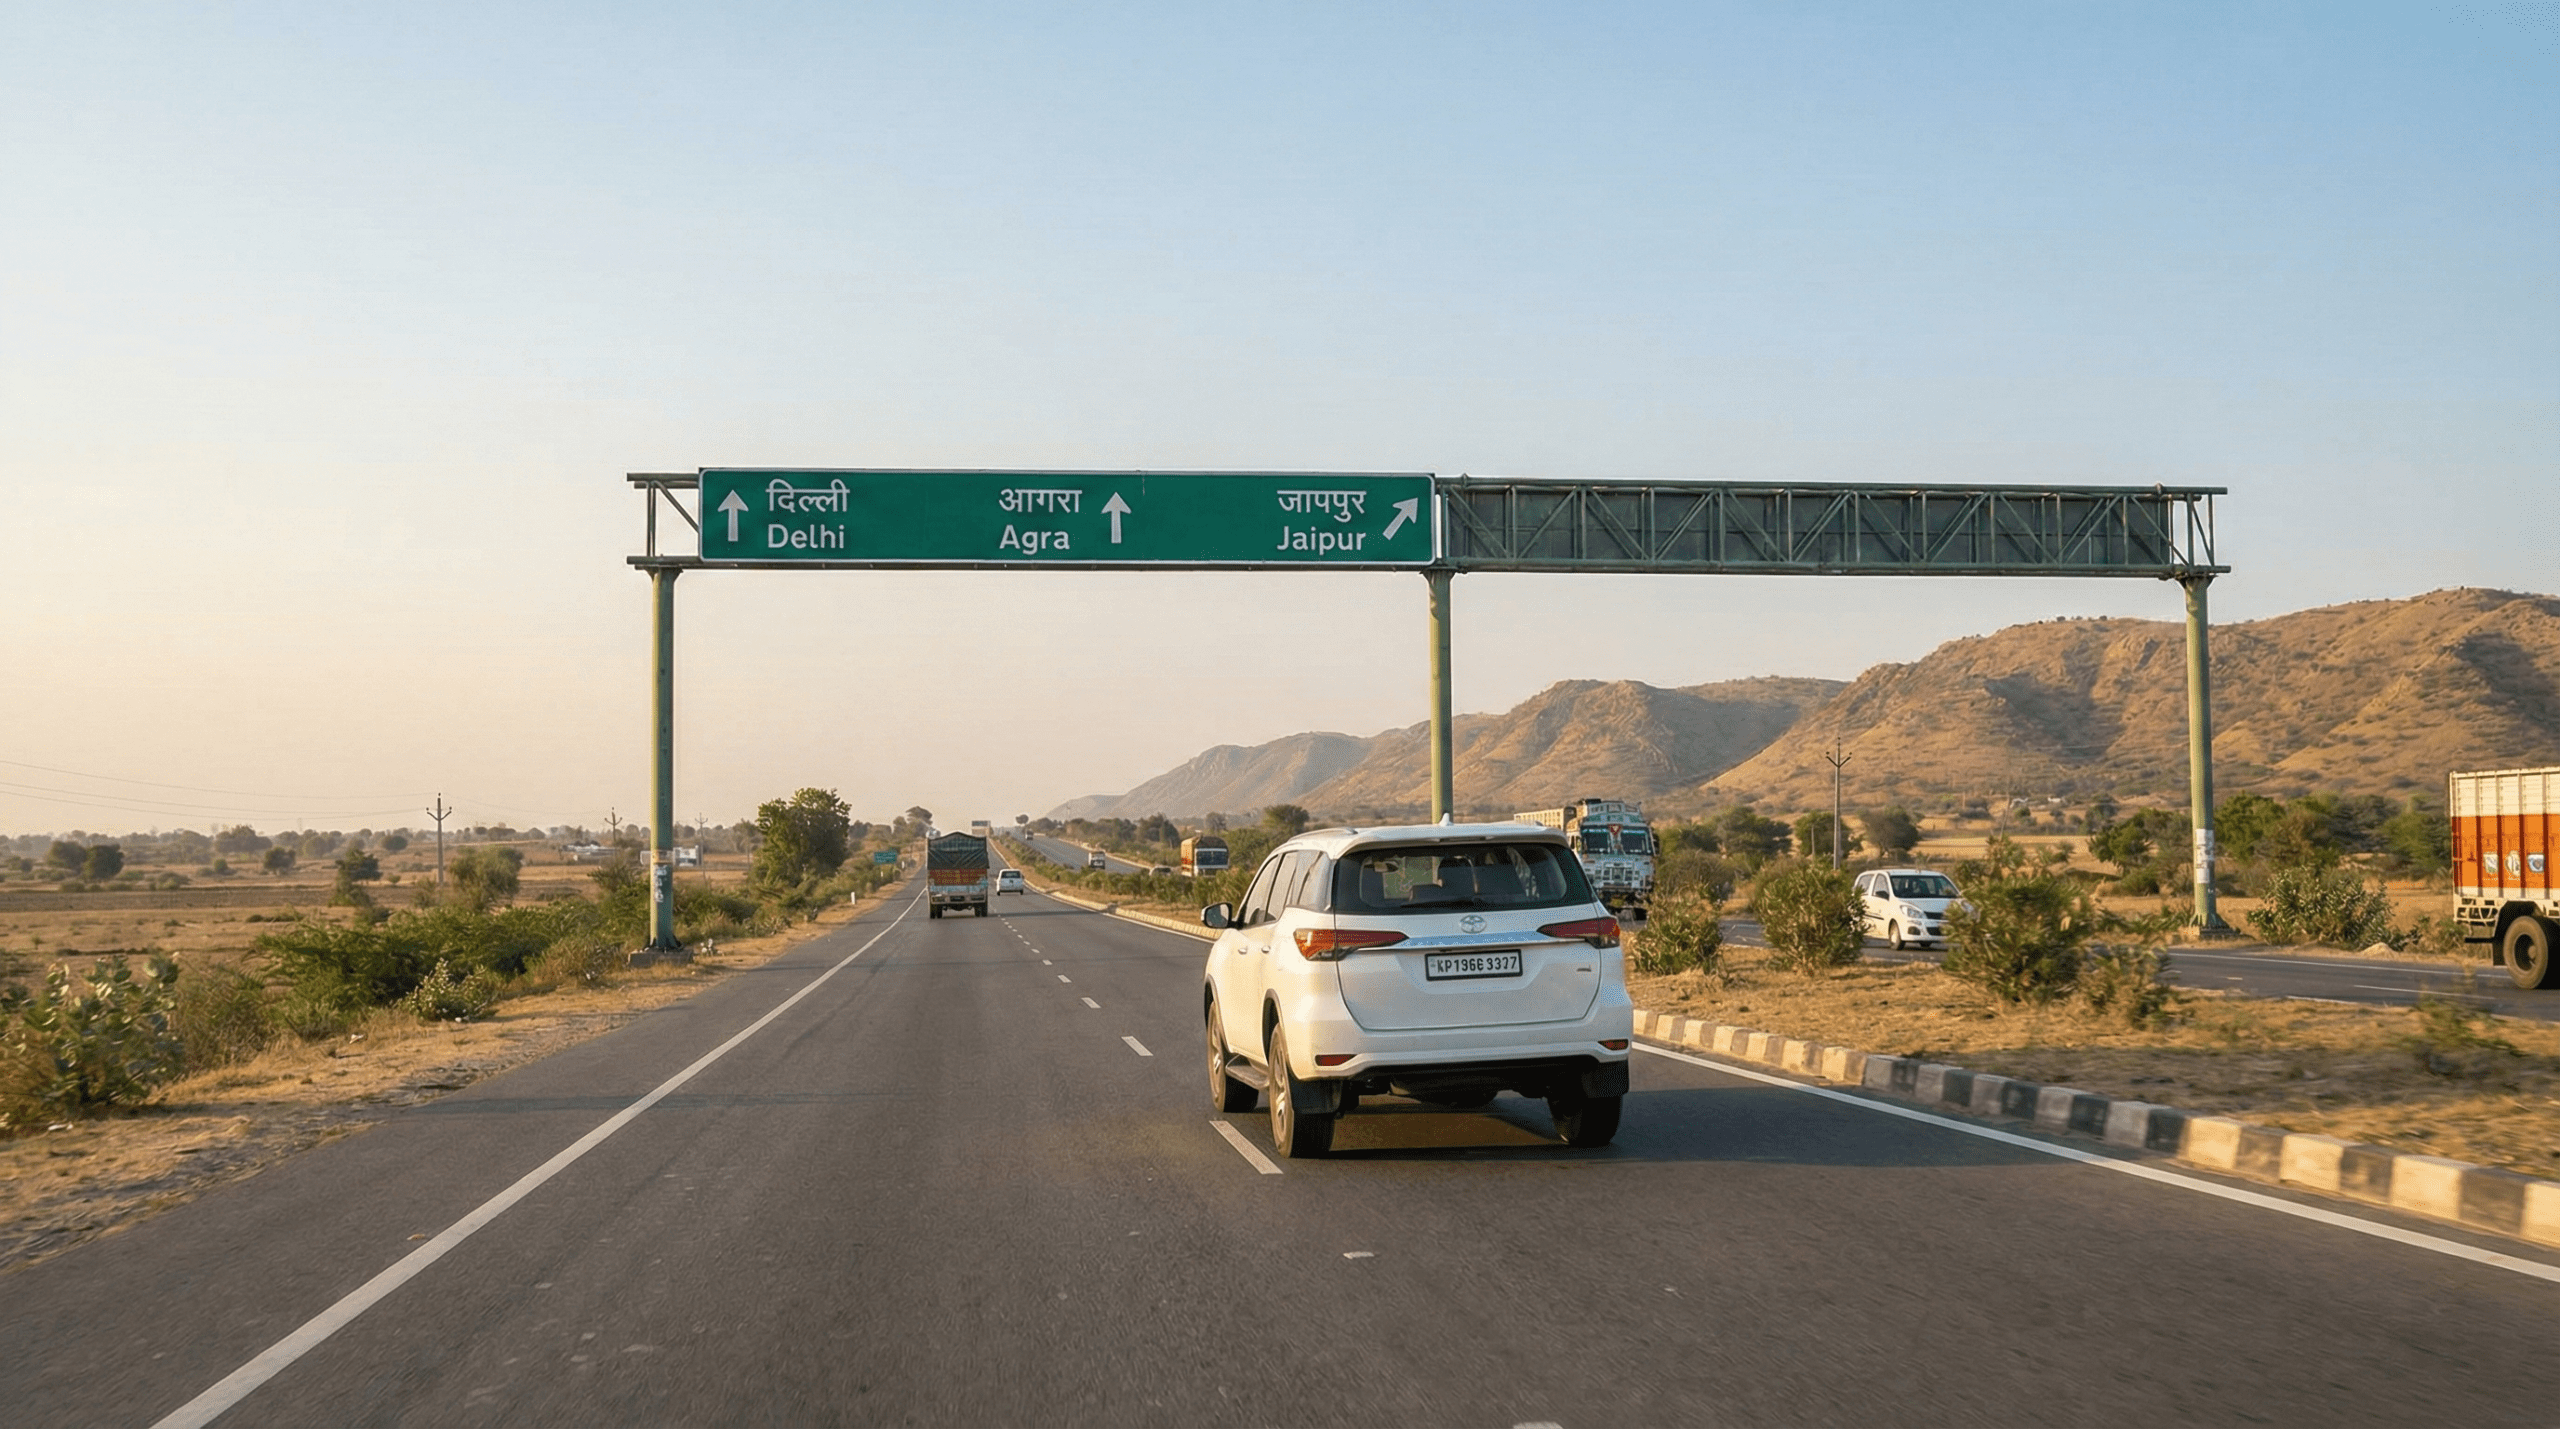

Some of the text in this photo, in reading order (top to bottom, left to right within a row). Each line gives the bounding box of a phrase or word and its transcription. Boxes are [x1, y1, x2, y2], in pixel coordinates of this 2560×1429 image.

[765, 478, 851, 513] दिल्ली
[998, 488, 1083, 513] आगरा
[1276, 490, 1367, 523] जापपुर
[767, 523, 845, 549] Delhi
[999, 524, 1071, 556] Agra
[1276, 525, 1367, 556] Jaipur
